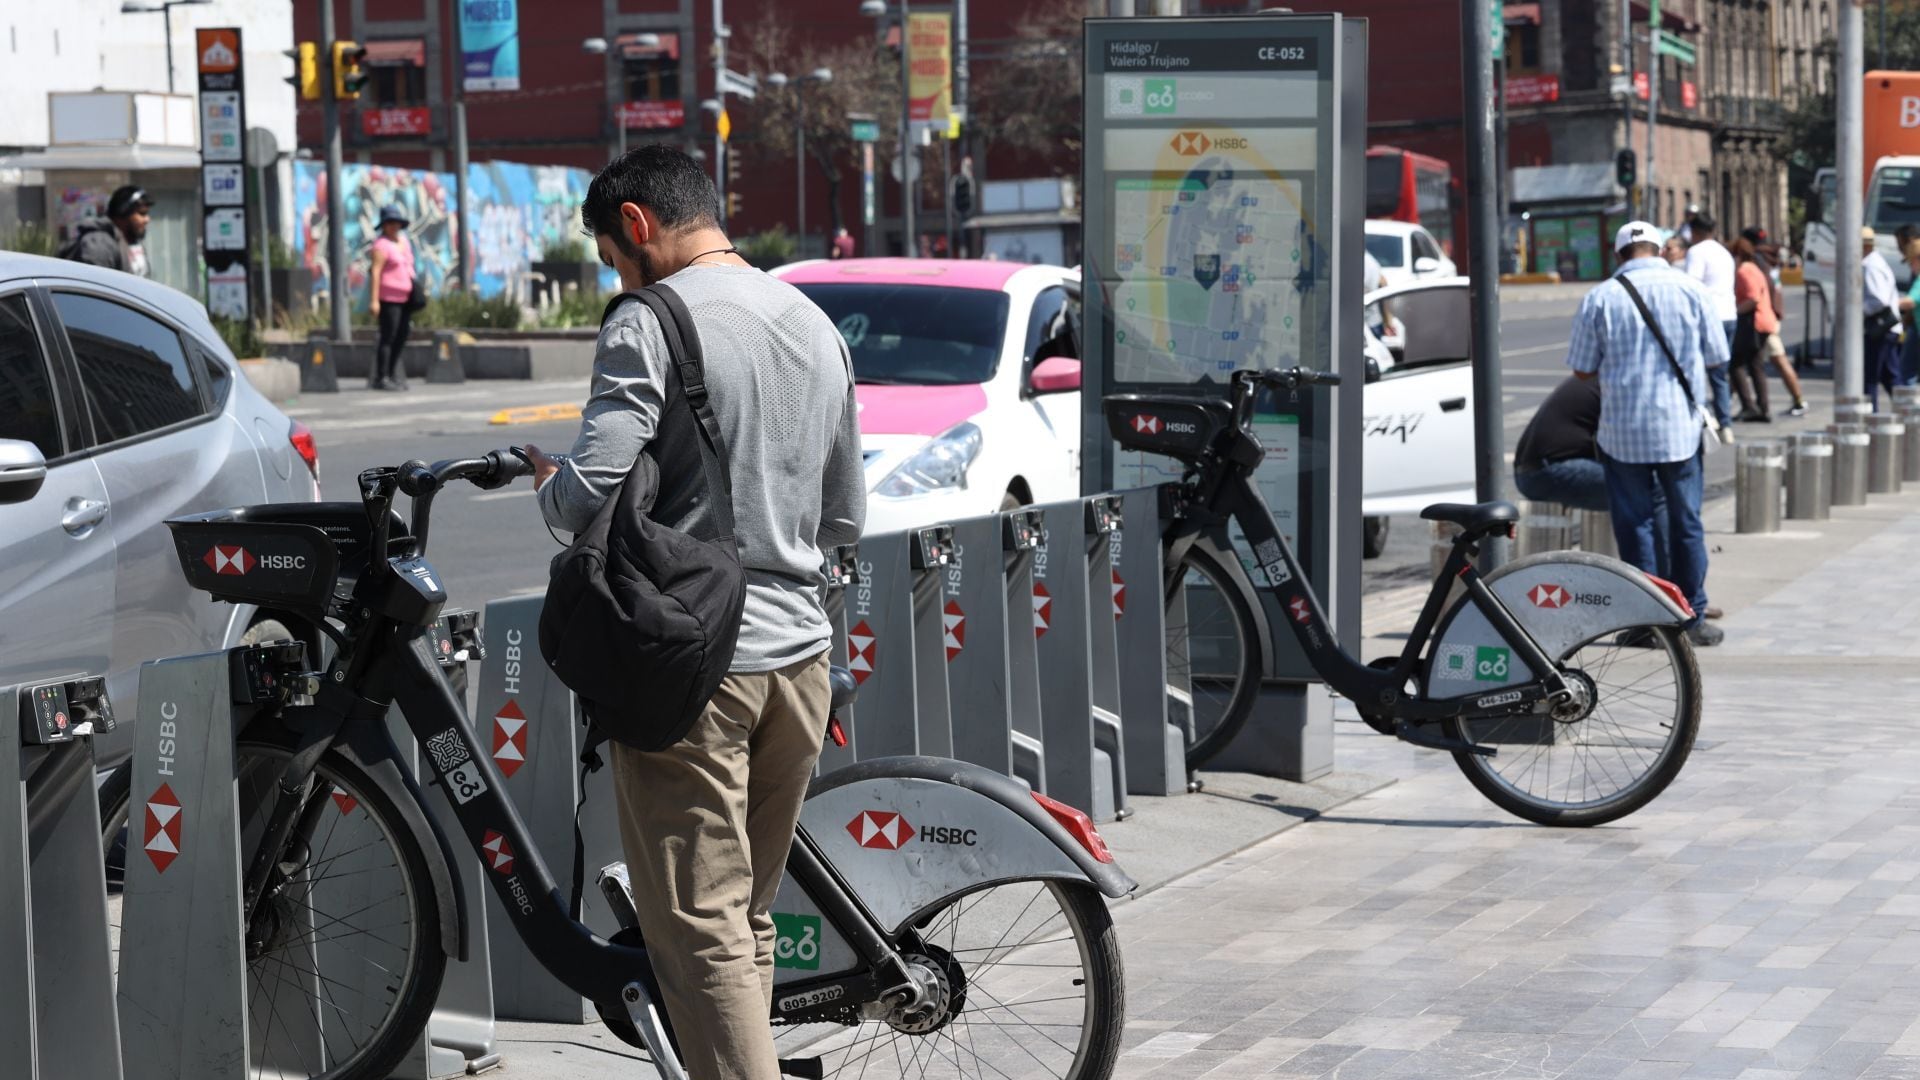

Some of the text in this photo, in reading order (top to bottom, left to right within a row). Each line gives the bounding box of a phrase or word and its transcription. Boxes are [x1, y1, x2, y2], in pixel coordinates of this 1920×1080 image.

[1110, 42, 1152, 56] Hidalgo
[1258, 47, 1305, 60] CE-052
[1110, 55, 1190, 69] Valerio Trujano
[1900, 96, 1920, 128] B
[1214, 138, 1248, 150] HSBC
[1166, 422, 1196, 433] HSBC
[1110, 531, 1122, 566] HSB
[260, 555, 306, 569] HSBC
[856, 561, 873, 616] HSBC
[1575, 593, 1612, 606] HSBC
[1305, 624, 1323, 649] HSBC
[505, 629, 522, 694] HSBC
[158, 702, 178, 776] HSBC
[920, 825, 978, 847] HSBC
[507, 875, 533, 916] HSBC
[783, 989, 843, 1011] 809-9202
